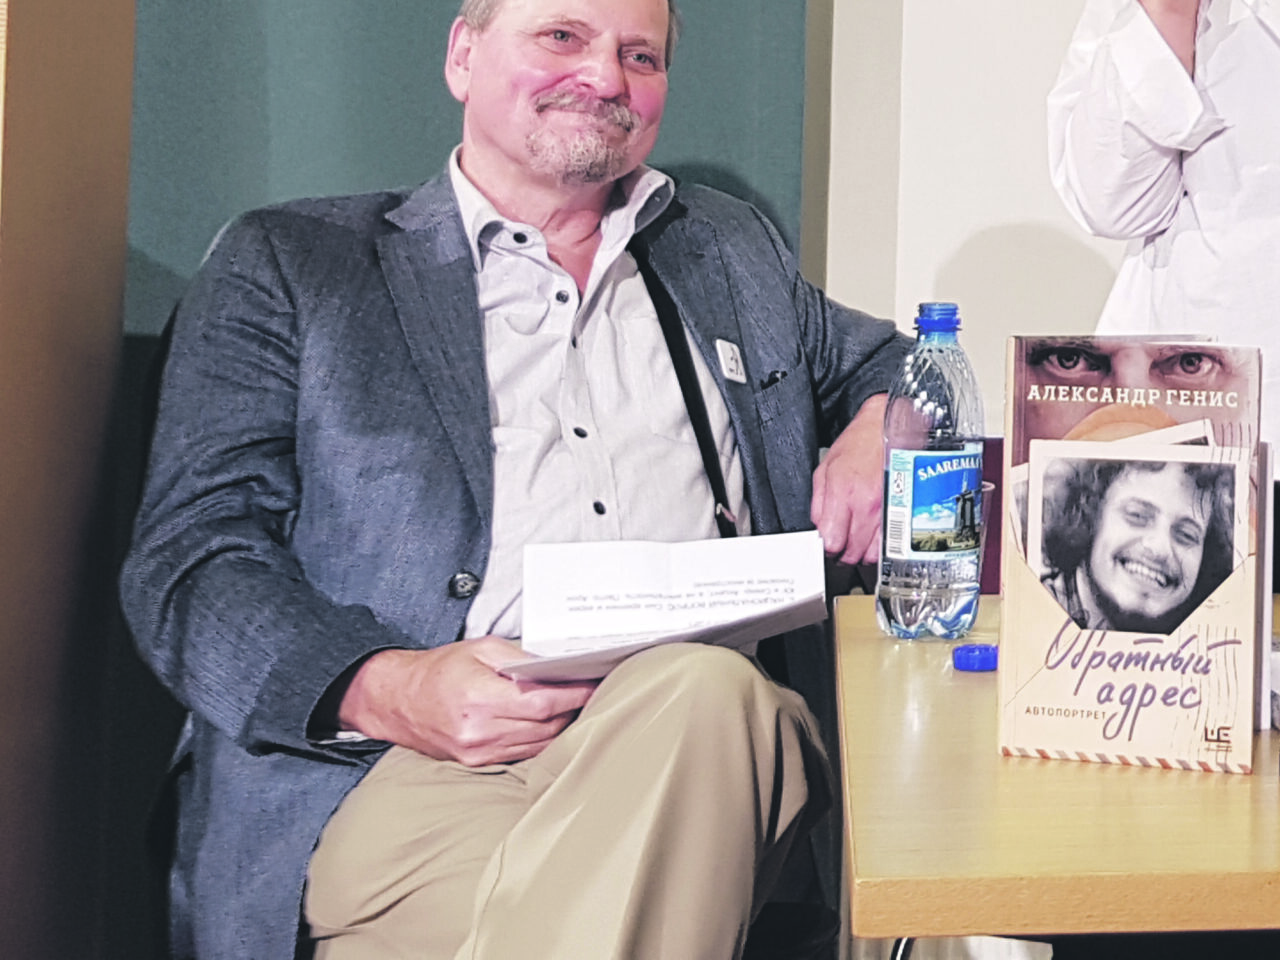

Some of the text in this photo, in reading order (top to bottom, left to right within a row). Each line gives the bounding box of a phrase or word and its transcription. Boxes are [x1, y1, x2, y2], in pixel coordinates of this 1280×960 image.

[1027, 384, 1238, 408] АЛЕКСАНДР ГЕНИС
[1045, 618, 1242, 696] Обратный
[1025, 705, 1106, 720] АВТОПОРТРЕТ
[1097, 682, 1202, 742] адрес
